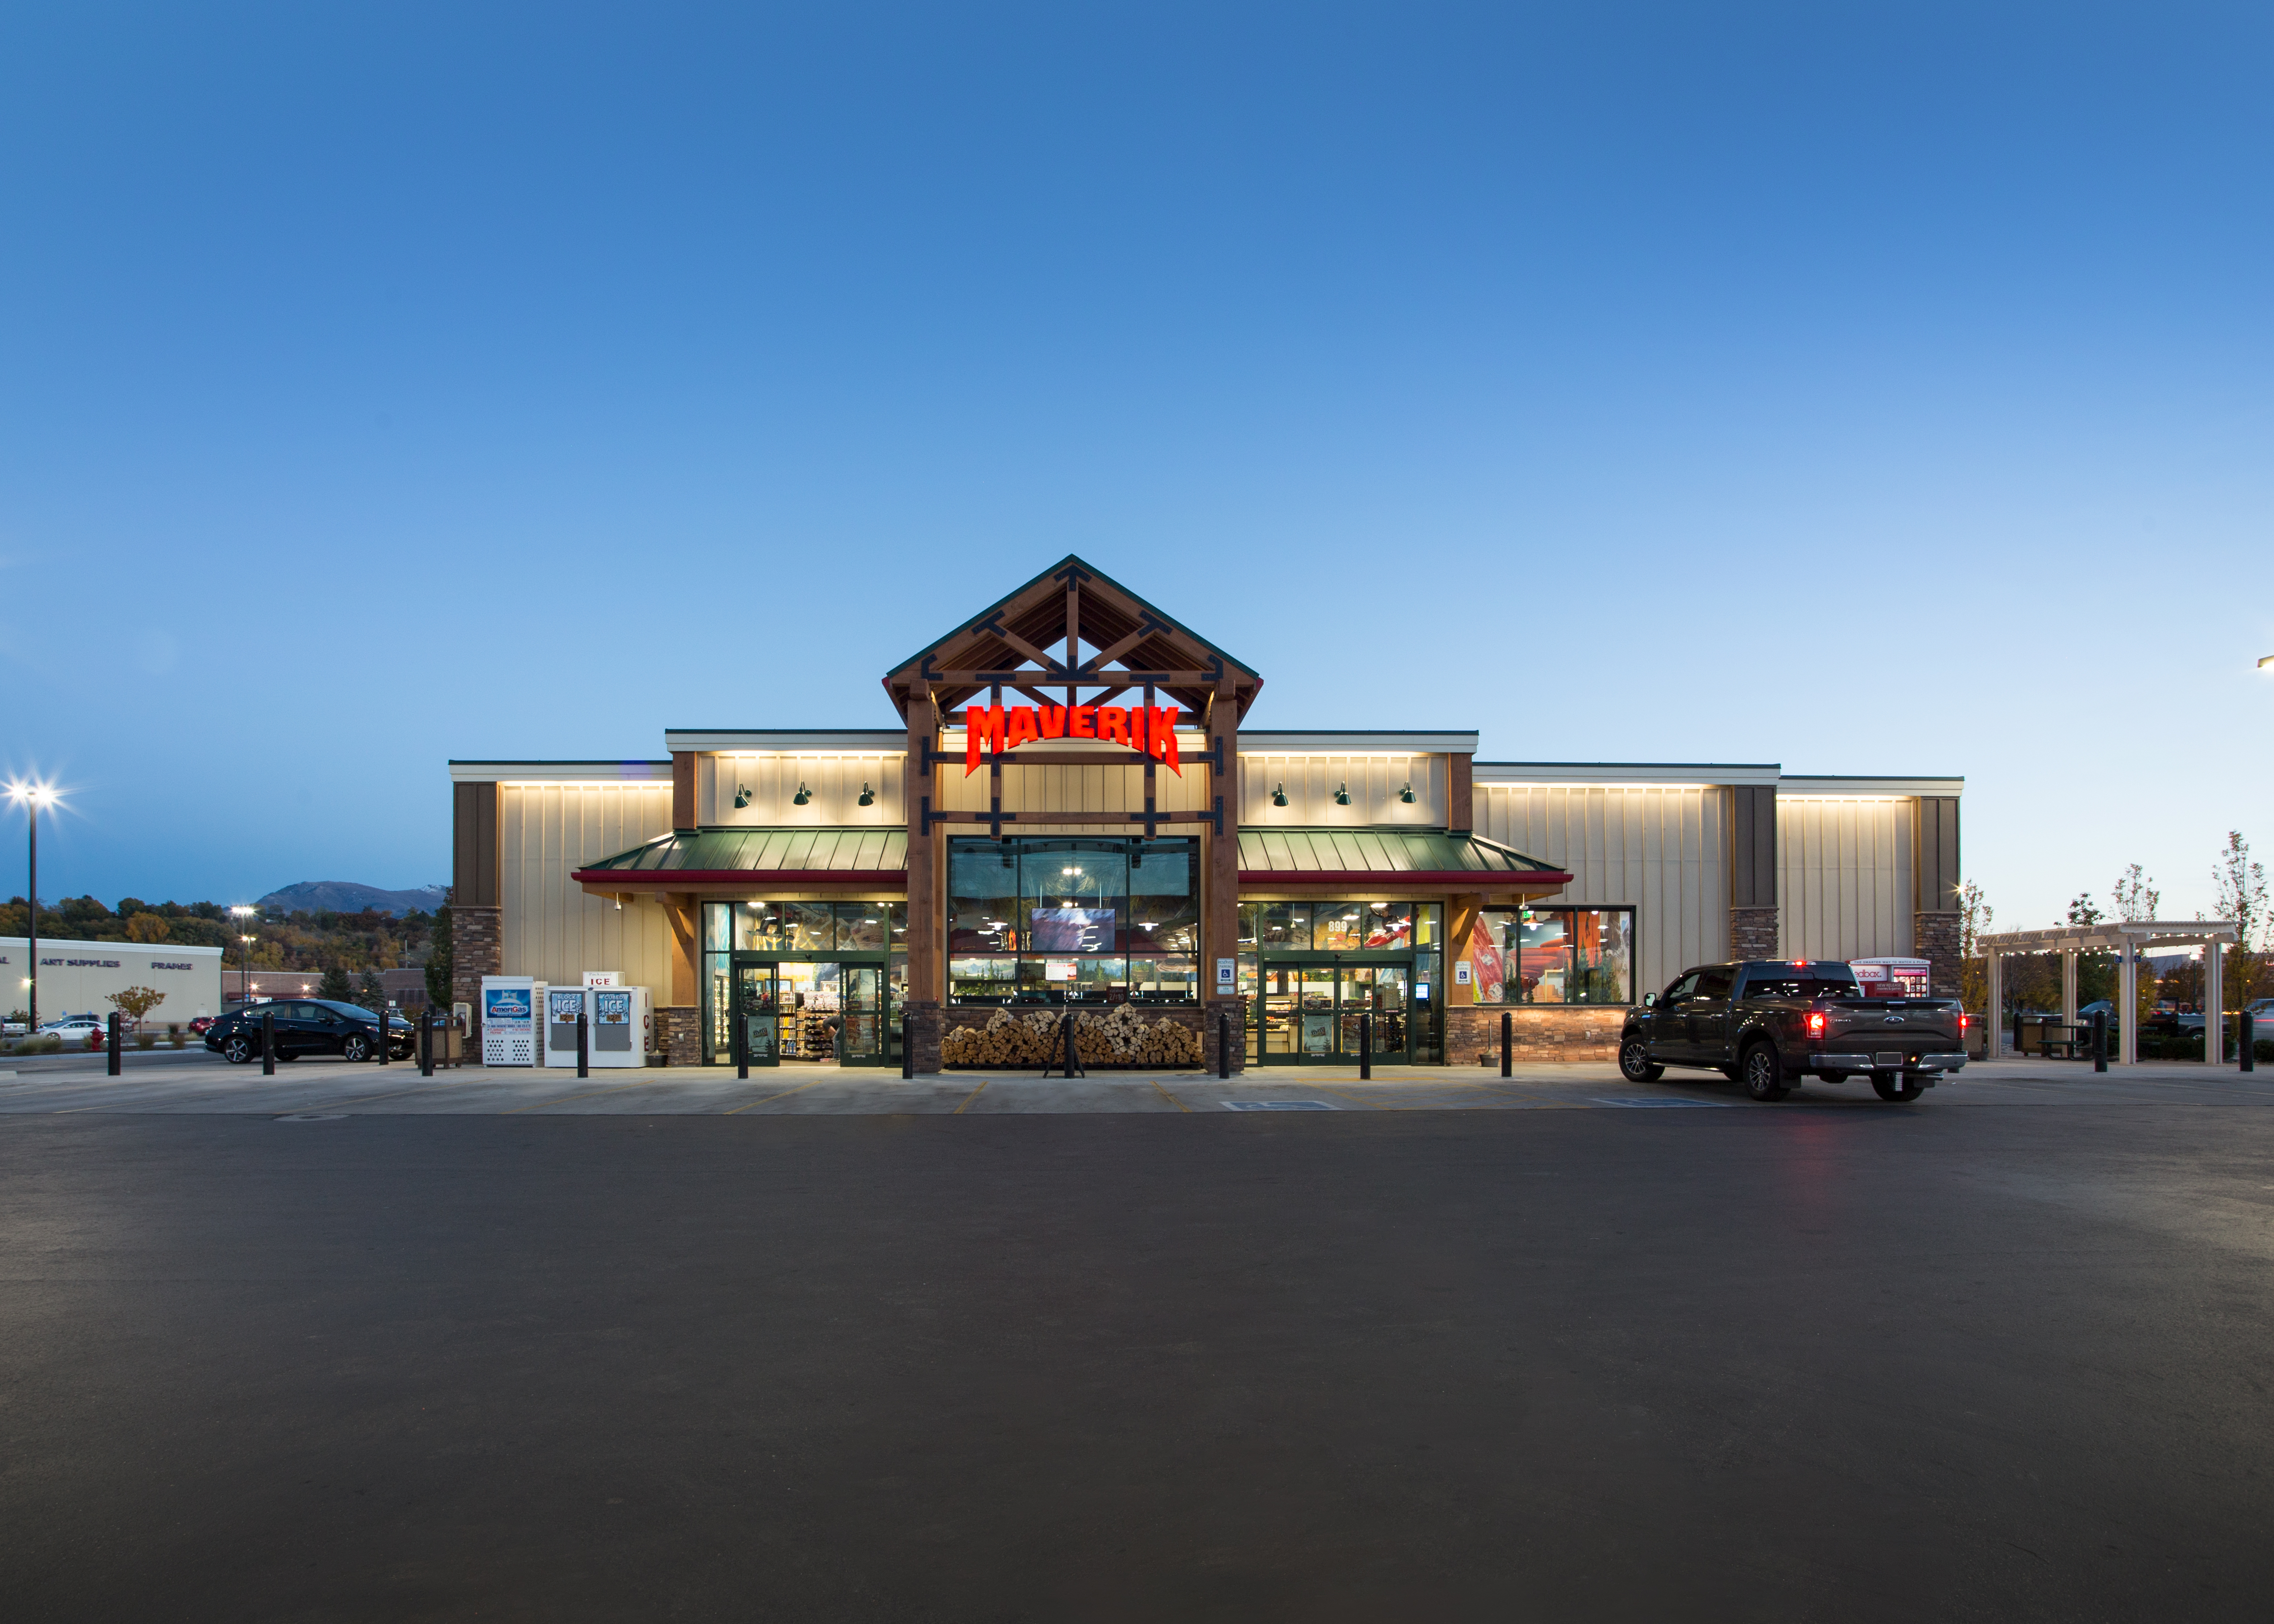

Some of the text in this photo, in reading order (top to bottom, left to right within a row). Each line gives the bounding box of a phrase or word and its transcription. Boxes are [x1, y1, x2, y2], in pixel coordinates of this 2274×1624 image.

[965, 705, 1182, 778] MAVERIK
[1328, 920, 1347, 932] 899
[66, 959, 121, 968] SUPPLIES
[151, 962, 193, 970] FRAMES
[1854, 969, 1882, 978] edbox.
[557, 1000, 577, 1012] ICE
[604, 1000, 623, 1012] ICE
